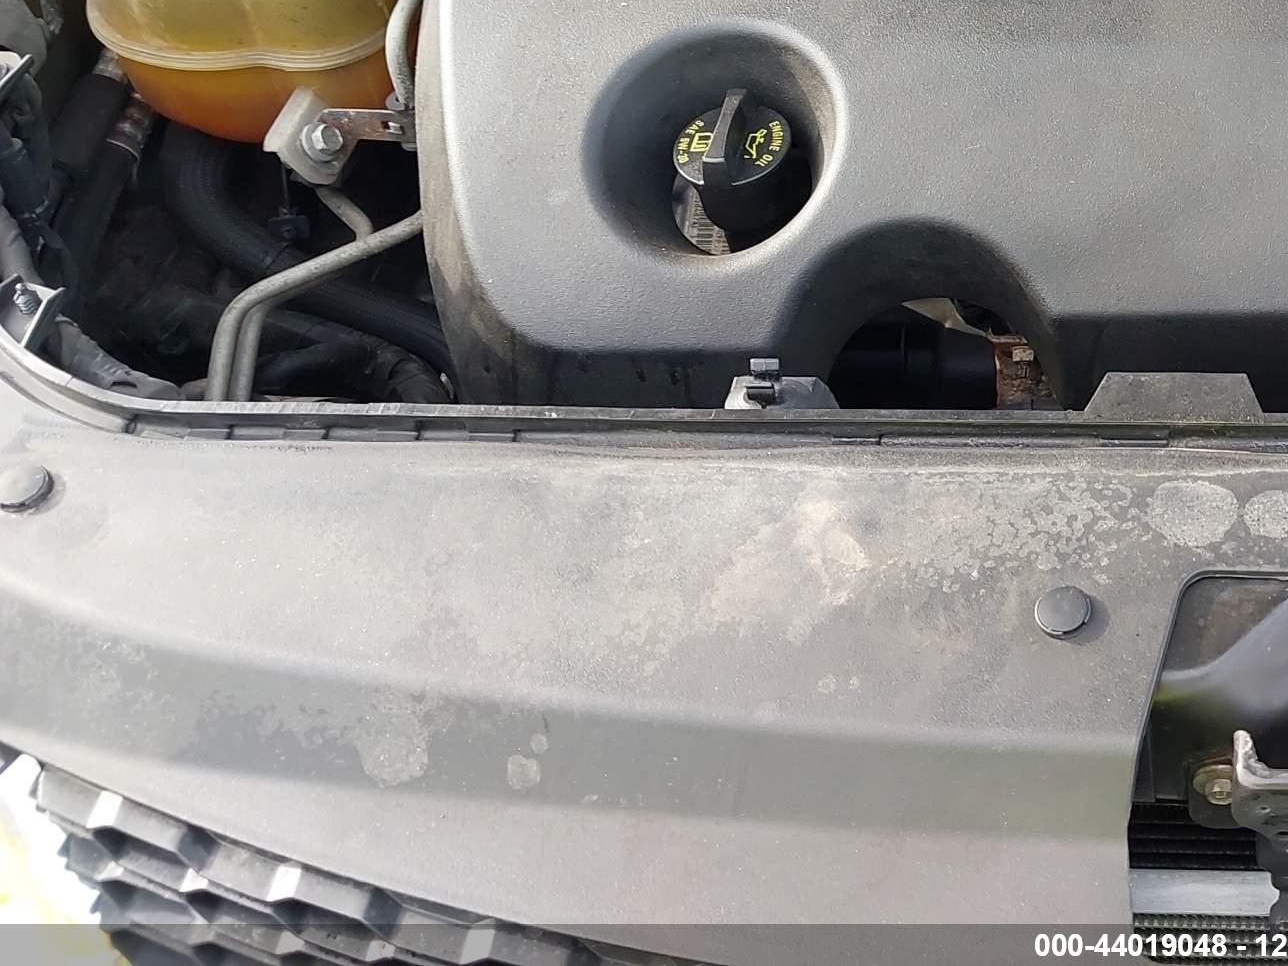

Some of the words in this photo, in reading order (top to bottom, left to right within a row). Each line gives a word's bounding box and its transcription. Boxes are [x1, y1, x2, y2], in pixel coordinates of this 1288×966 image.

[685, 120, 704, 135] SAE
[769, 121, 783, 151] ENGINE
[755, 154, 773, 167] OIL
